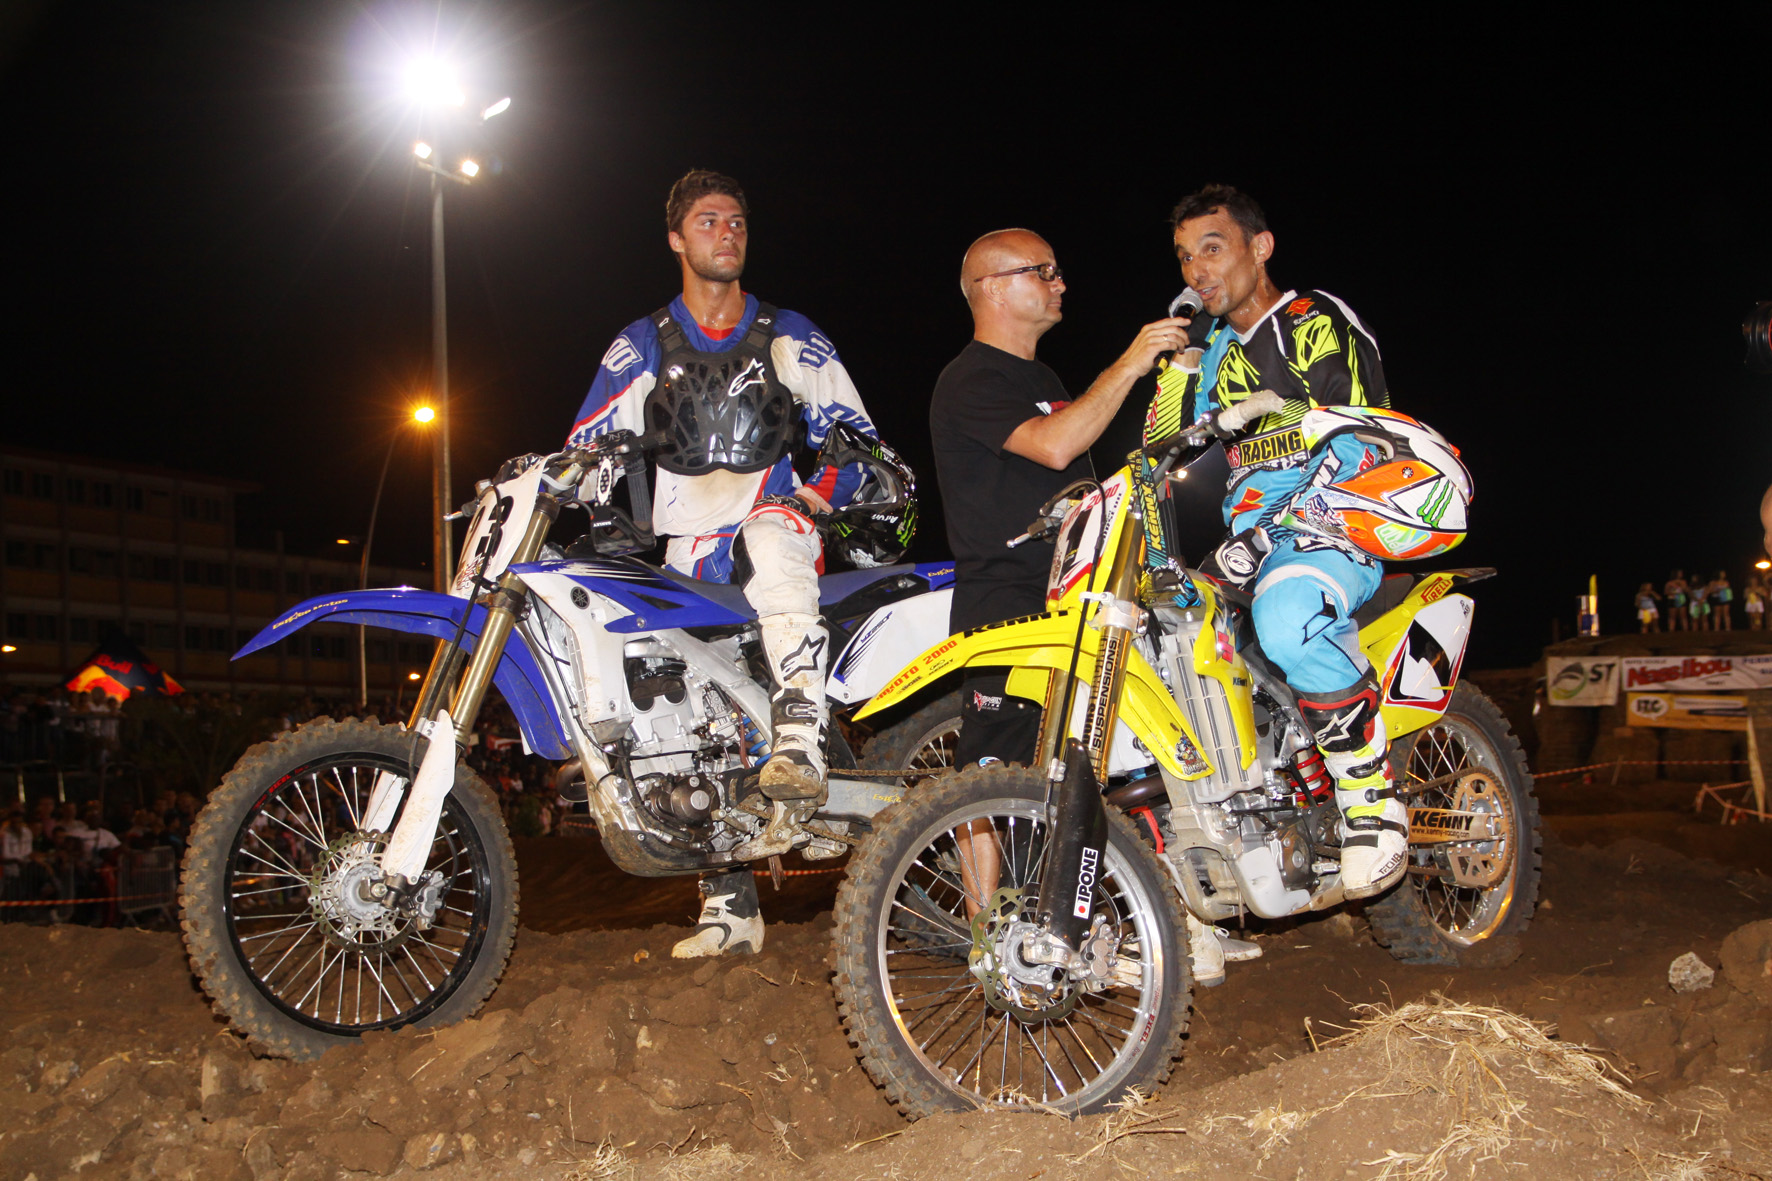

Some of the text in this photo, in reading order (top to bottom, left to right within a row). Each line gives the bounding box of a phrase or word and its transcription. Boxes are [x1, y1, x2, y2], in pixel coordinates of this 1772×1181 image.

[1241, 430, 1301, 466] RACING
[1142, 483, 1163, 551] KENNY
[1421, 576, 1453, 604] PIRELLI
[922, 640, 958, 665] 2000
[1589, 663, 1616, 683] ST
[1091, 638, 1118, 750] SUSPENSIONS
[1411, 810, 1474, 831] KENNY
[1079, 848, 1098, 904] IPONE
[1140, 1013, 1156, 1043] EXCEL
